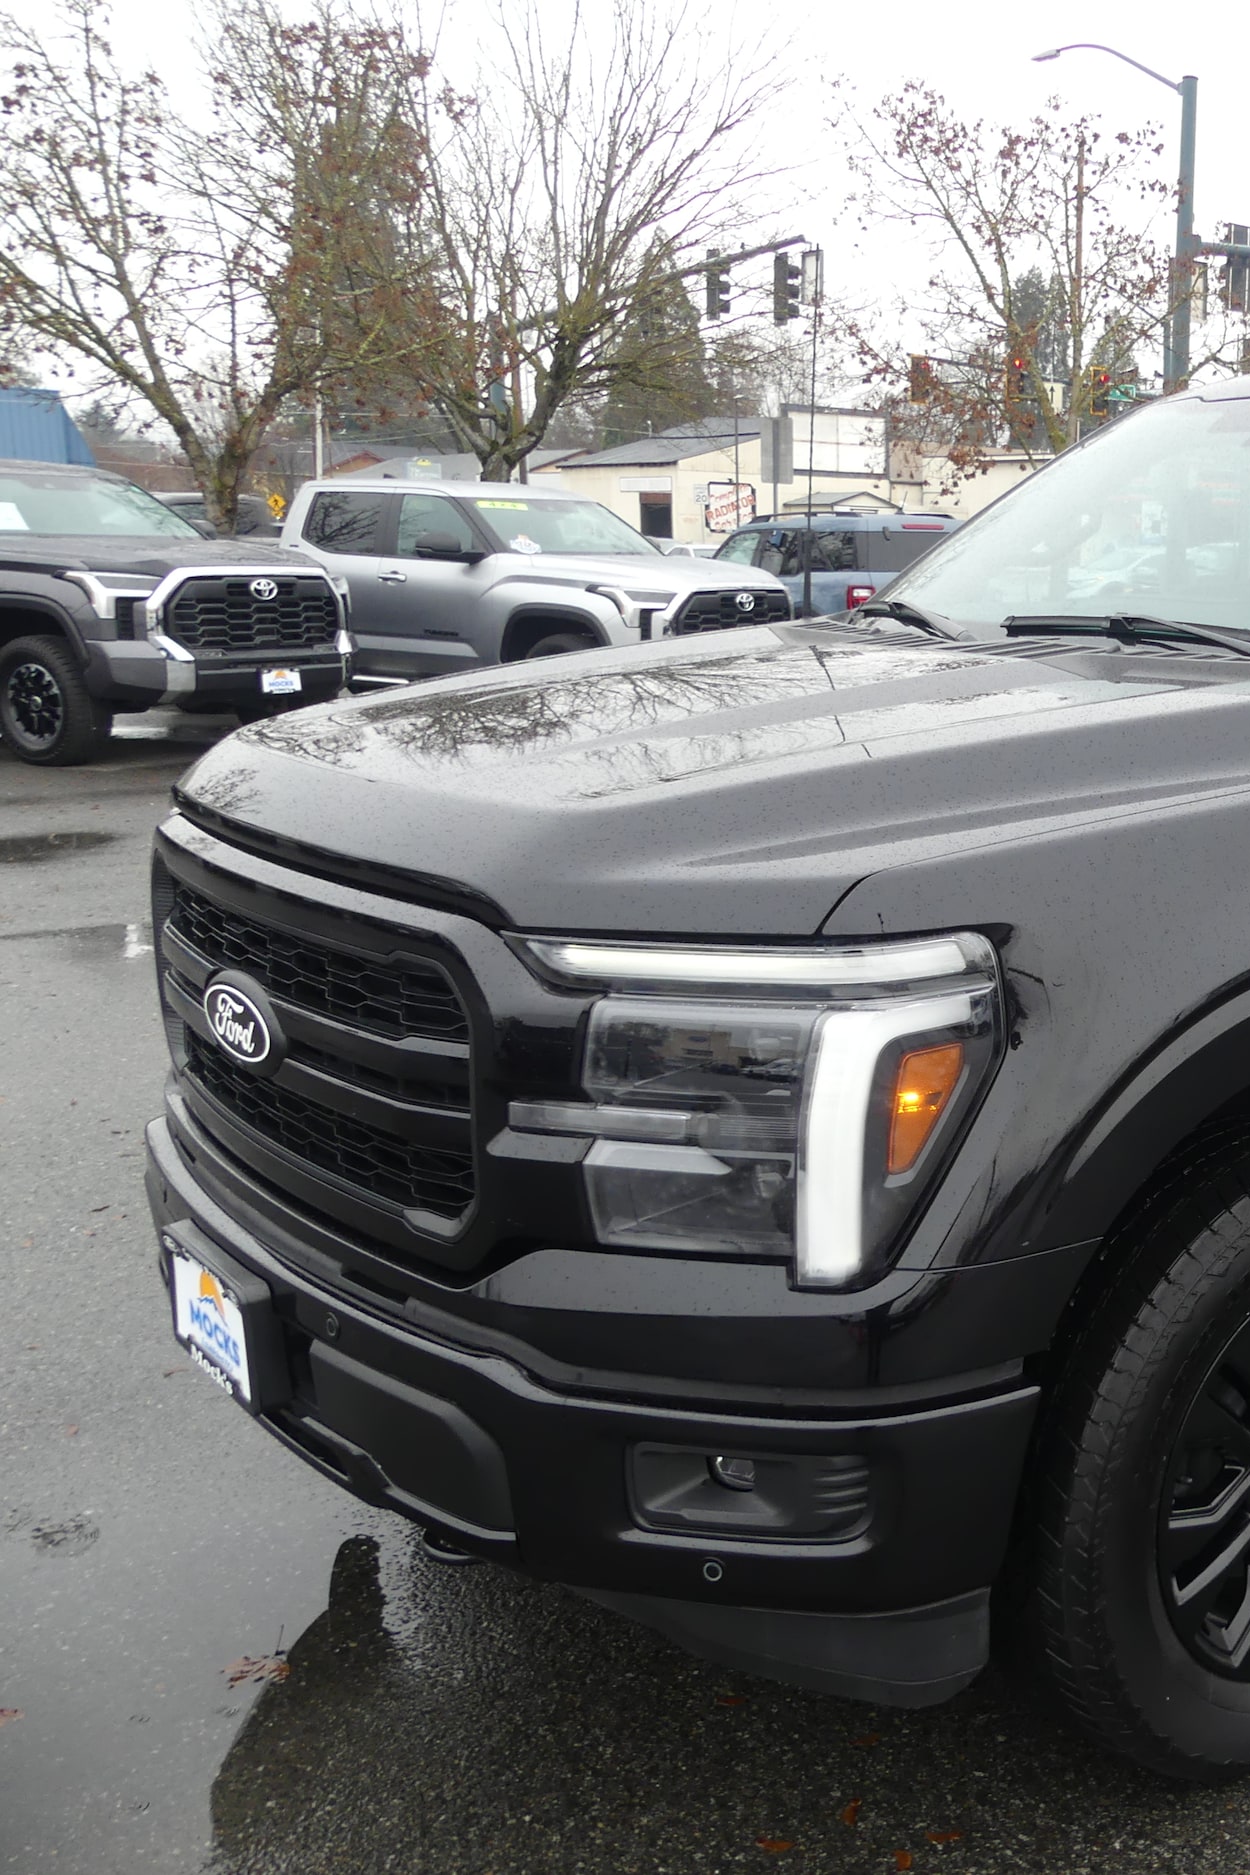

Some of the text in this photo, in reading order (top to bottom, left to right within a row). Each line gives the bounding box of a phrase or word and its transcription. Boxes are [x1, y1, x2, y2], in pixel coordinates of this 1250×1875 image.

[695, 494, 708, 503] 20
[214, 992, 256, 1054] Ford
[189, 1300, 241, 1367] MOCKS
